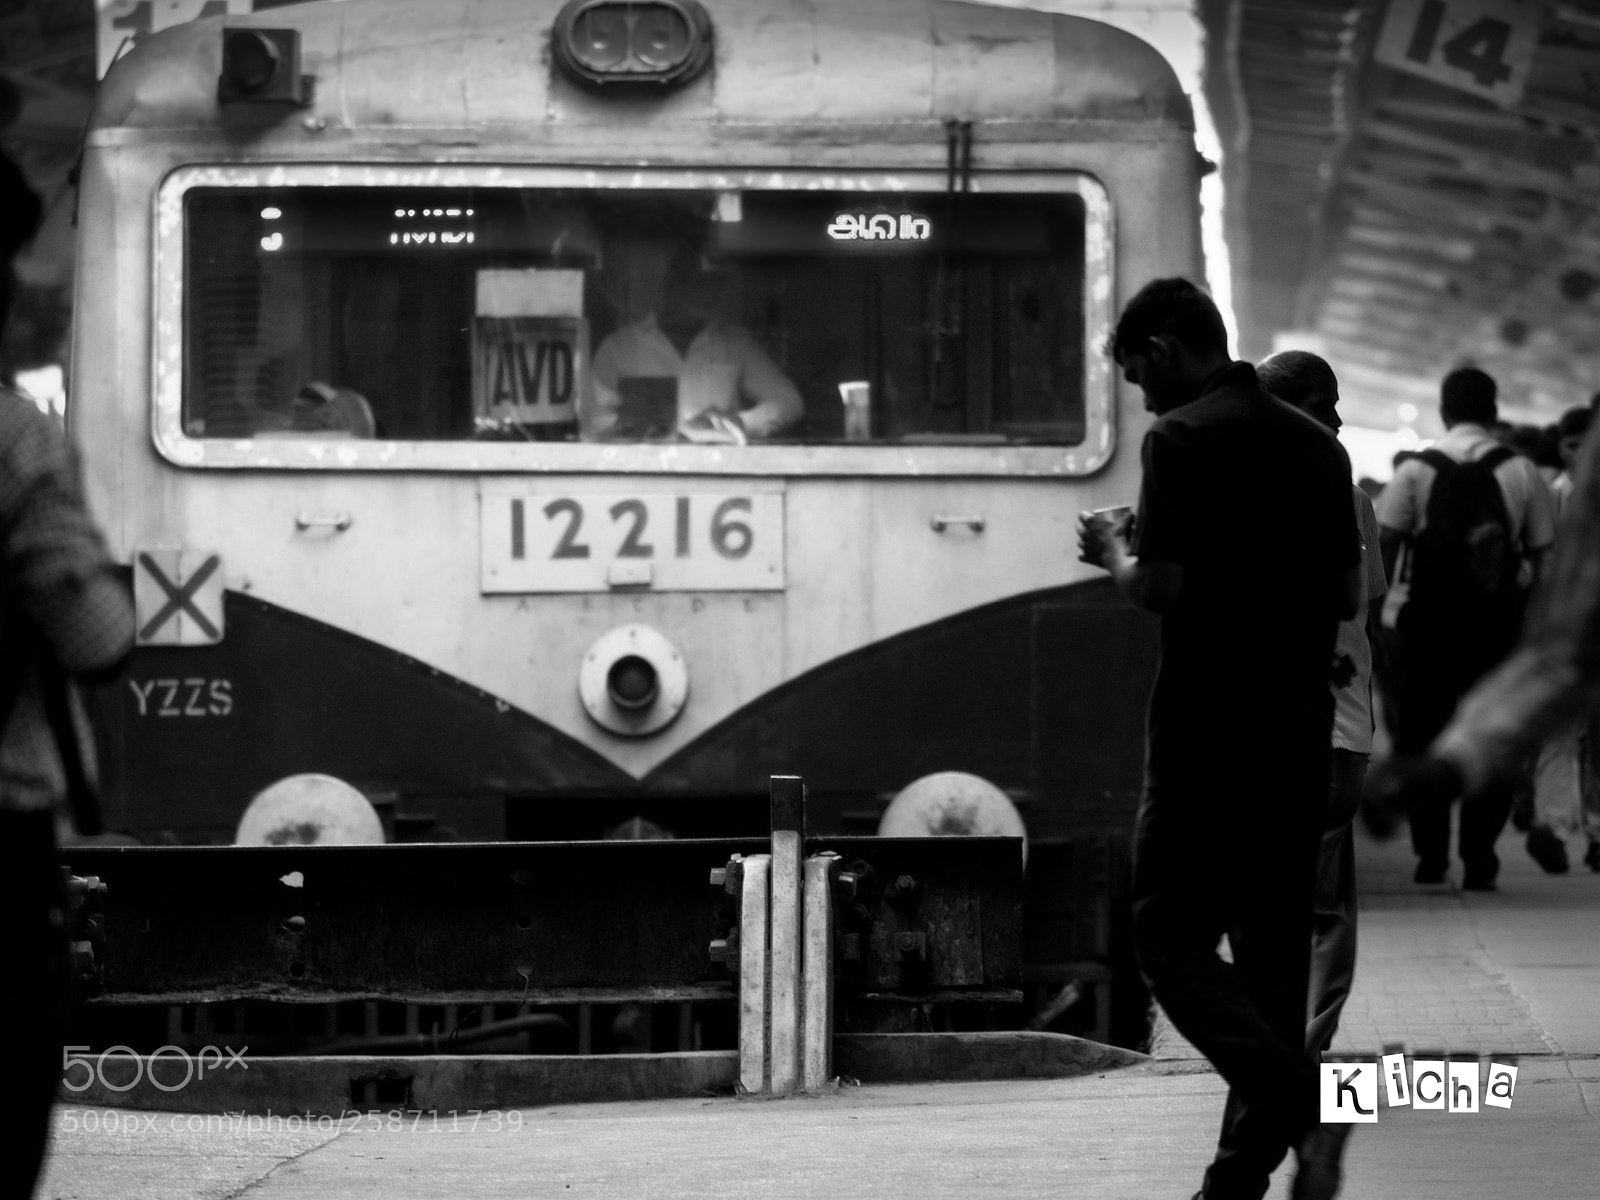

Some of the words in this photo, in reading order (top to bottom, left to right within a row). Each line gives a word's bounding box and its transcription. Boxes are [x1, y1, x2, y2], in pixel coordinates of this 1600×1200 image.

[1404, 0, 1512, 88] 14
[492, 340, 575, 406] AVD
[509, 496, 754, 560] 12216
[129, 677, 233, 716] YZZS
